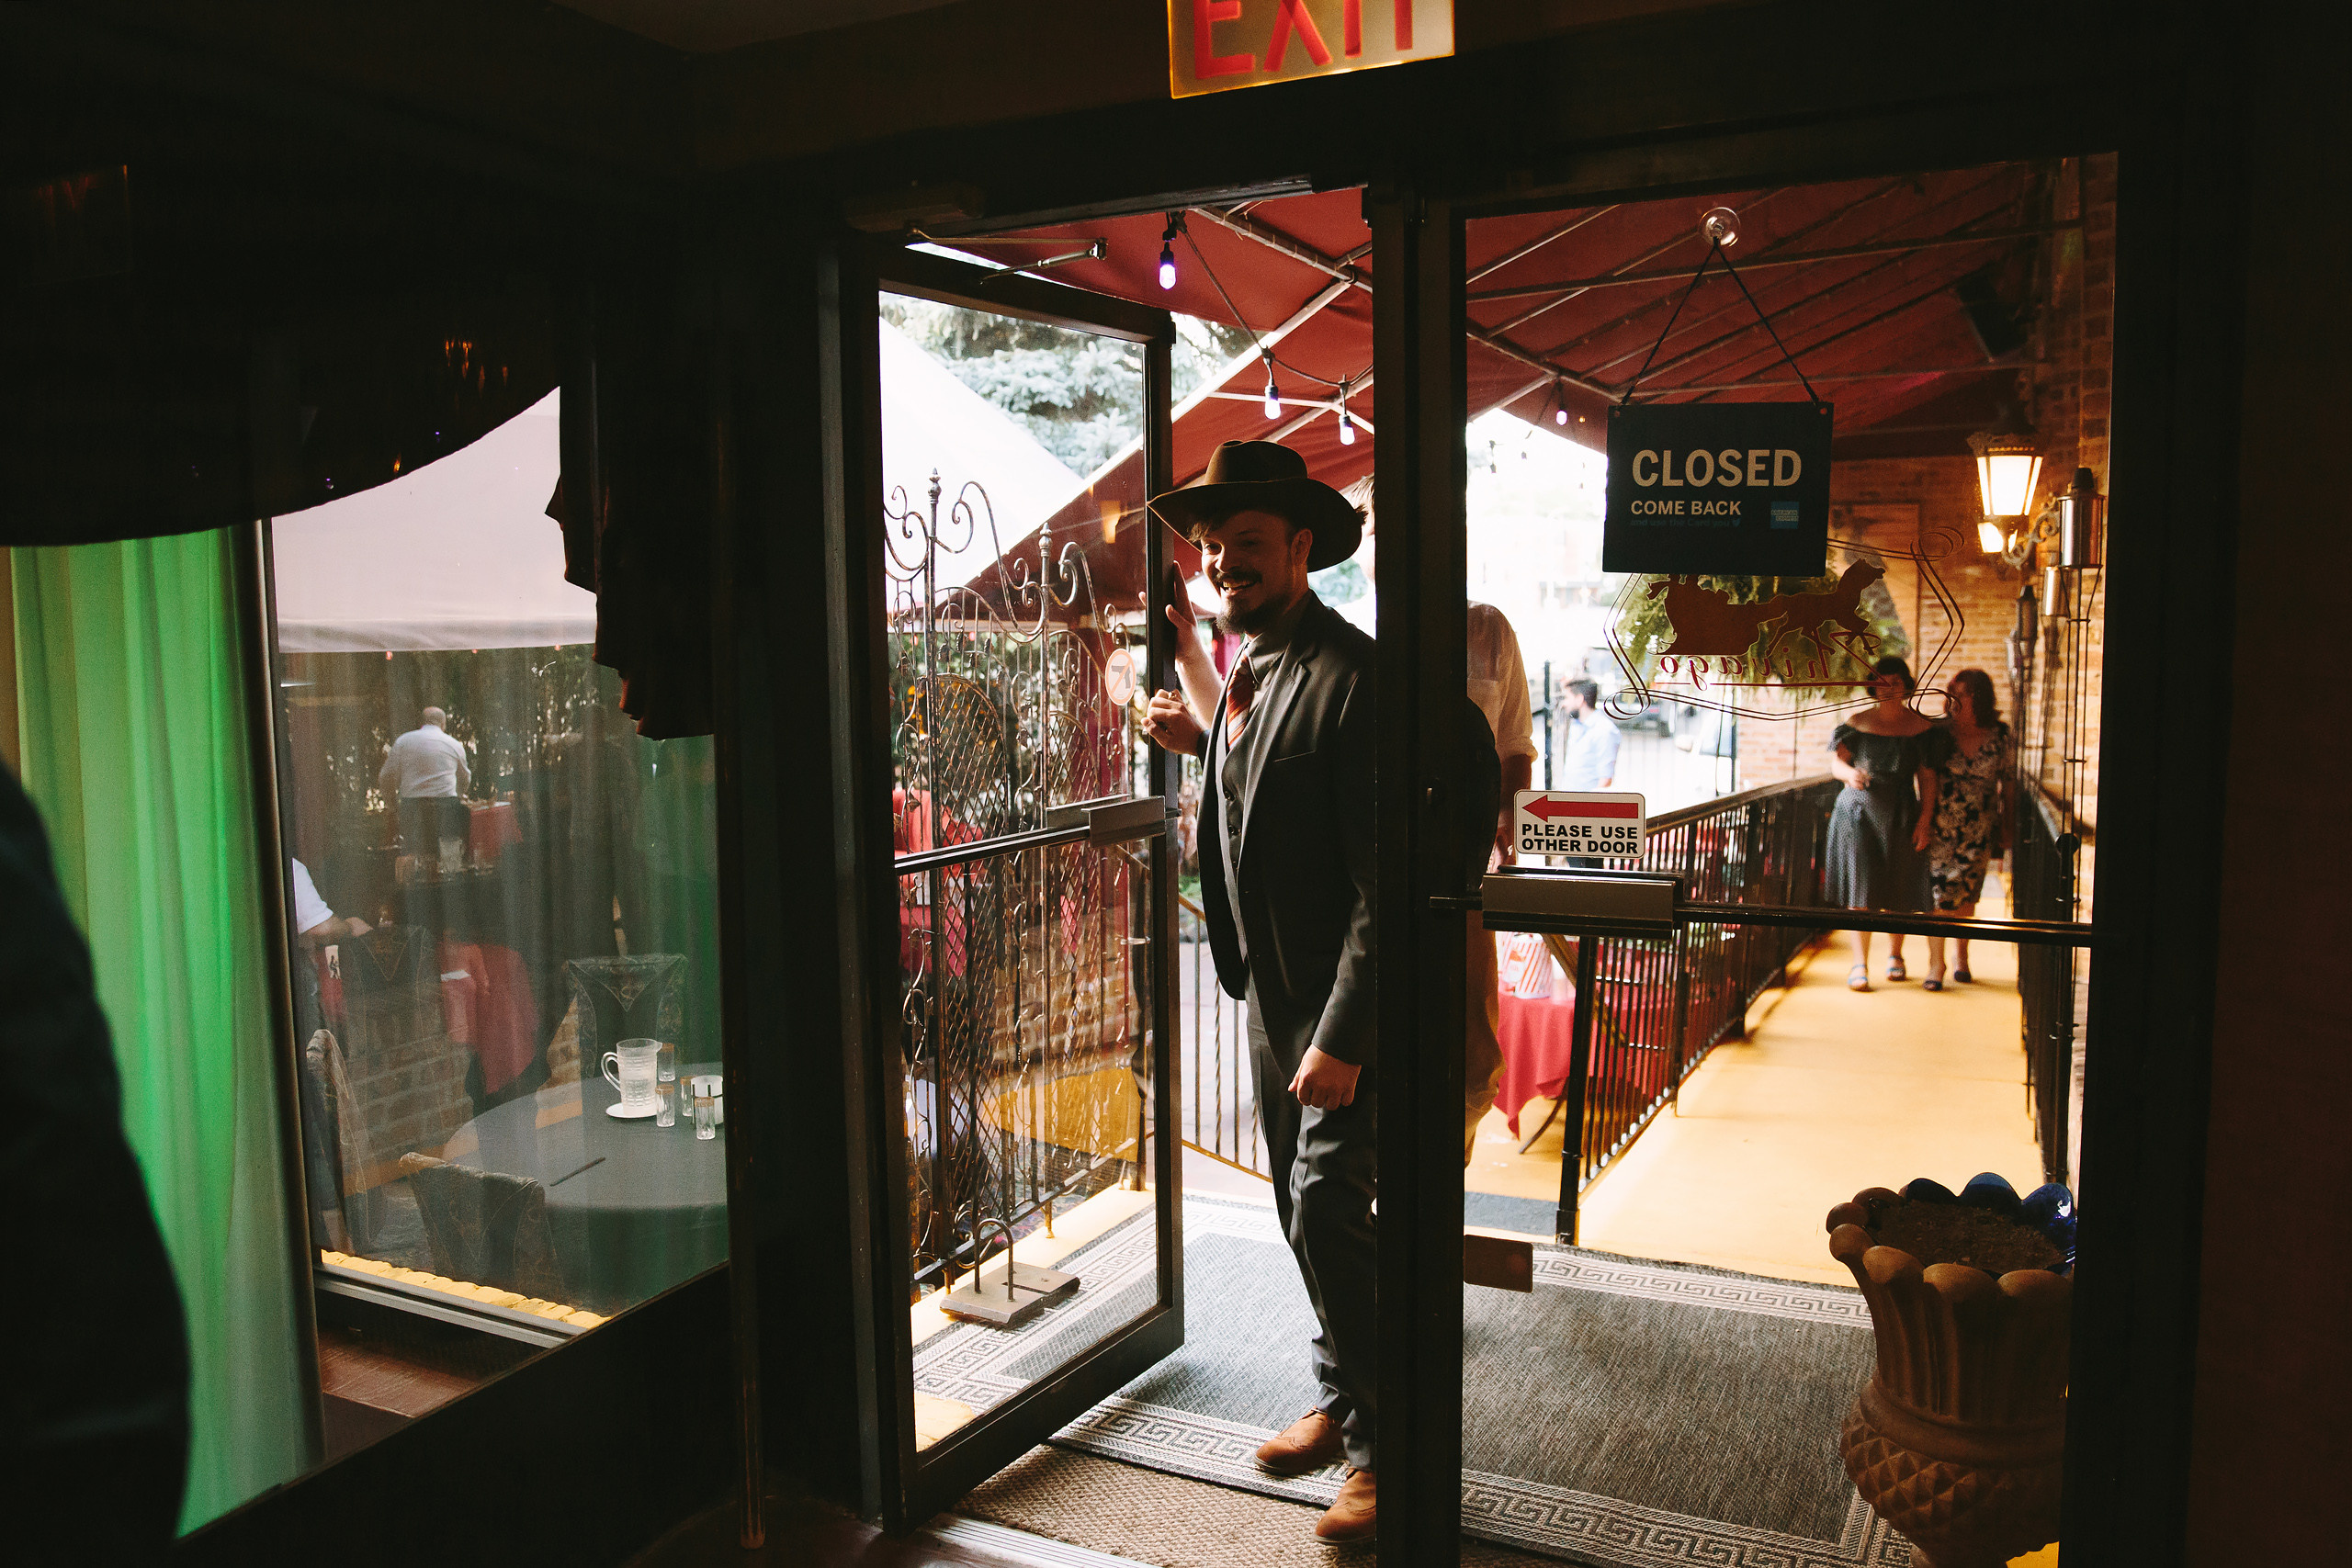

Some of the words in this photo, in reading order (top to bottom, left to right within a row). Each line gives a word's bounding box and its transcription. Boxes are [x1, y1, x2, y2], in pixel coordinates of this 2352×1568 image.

[1632, 448, 1803, 488] CLOSED
[1630, 500, 1685, 516] COME
[1690, 500, 1742, 516] BACK
[1521, 823, 1592, 838] PLEASE
[1600, 826, 1638, 840] USE
[1521, 838, 1581, 852] OTHER
[1587, 840, 1638, 854] DOOR
